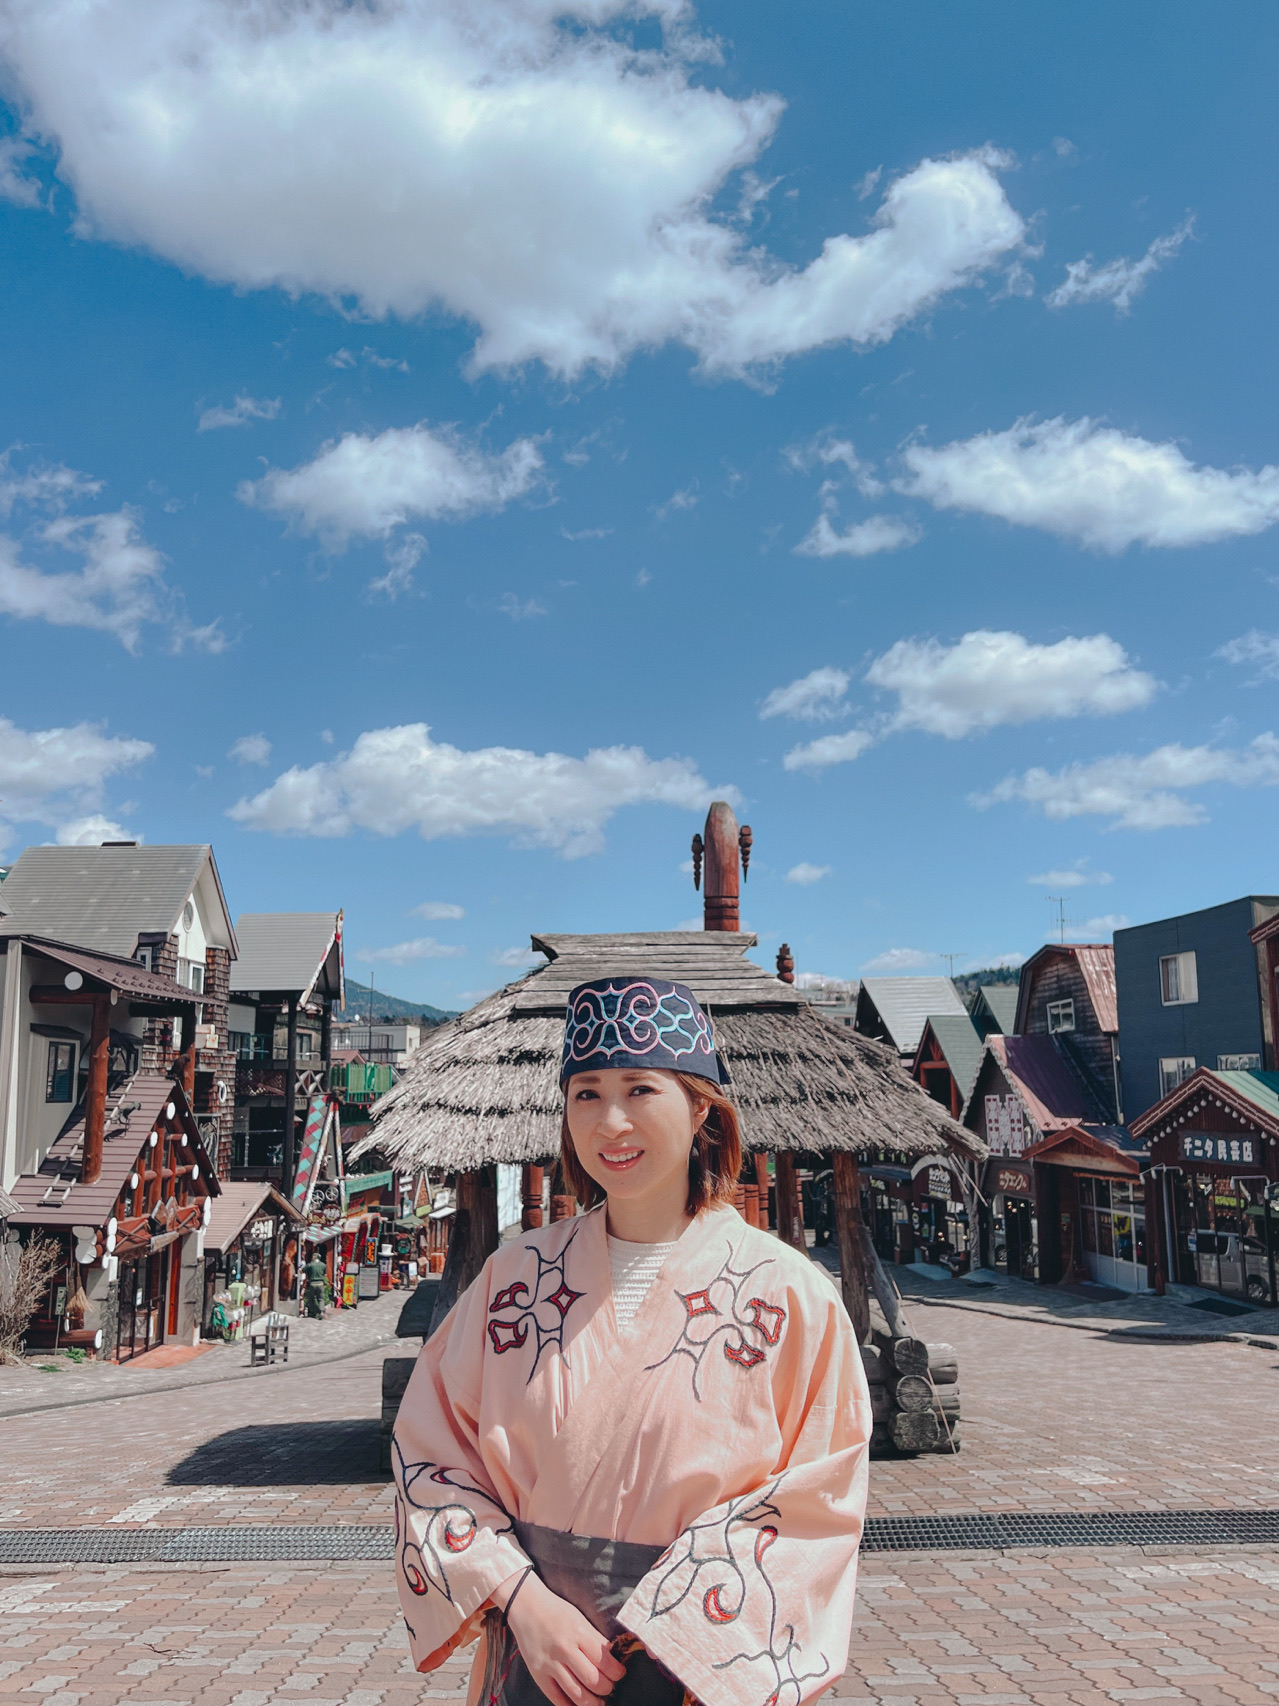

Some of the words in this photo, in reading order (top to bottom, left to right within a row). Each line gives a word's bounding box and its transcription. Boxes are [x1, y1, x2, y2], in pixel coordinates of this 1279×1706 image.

[1184, 1137, 1253, 1162] チニタ民芸店
